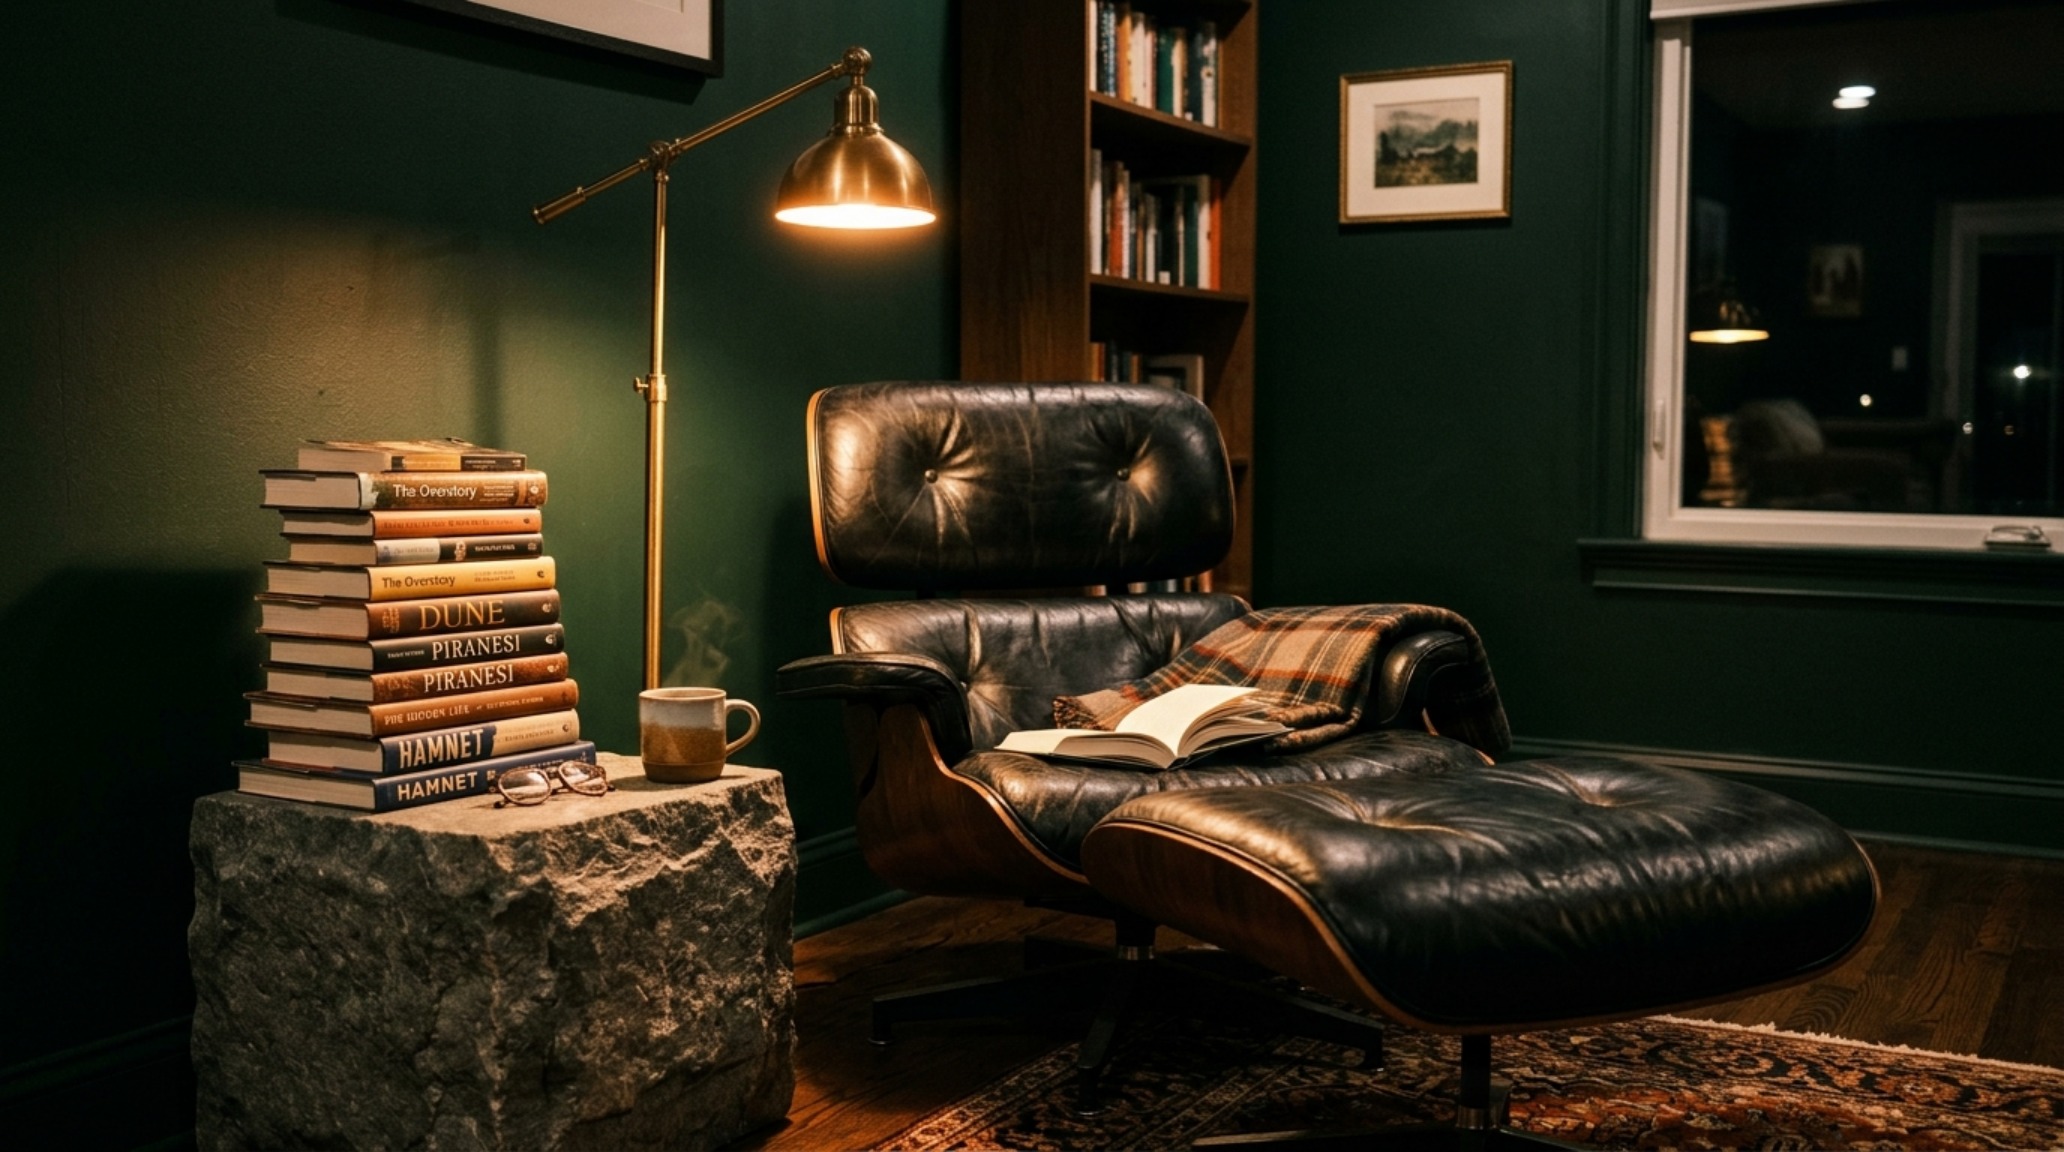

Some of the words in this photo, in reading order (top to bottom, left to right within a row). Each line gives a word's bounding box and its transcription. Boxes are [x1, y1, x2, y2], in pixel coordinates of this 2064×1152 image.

[382, 577, 402, 588] The
[419, 600, 505, 630] DUNE
[432, 634, 520, 660] PIRANESI
[423, 664, 514, 693] PIRANESI
[399, 728, 484, 769] HAMNET
[397, 771, 478, 801] HAMNET
